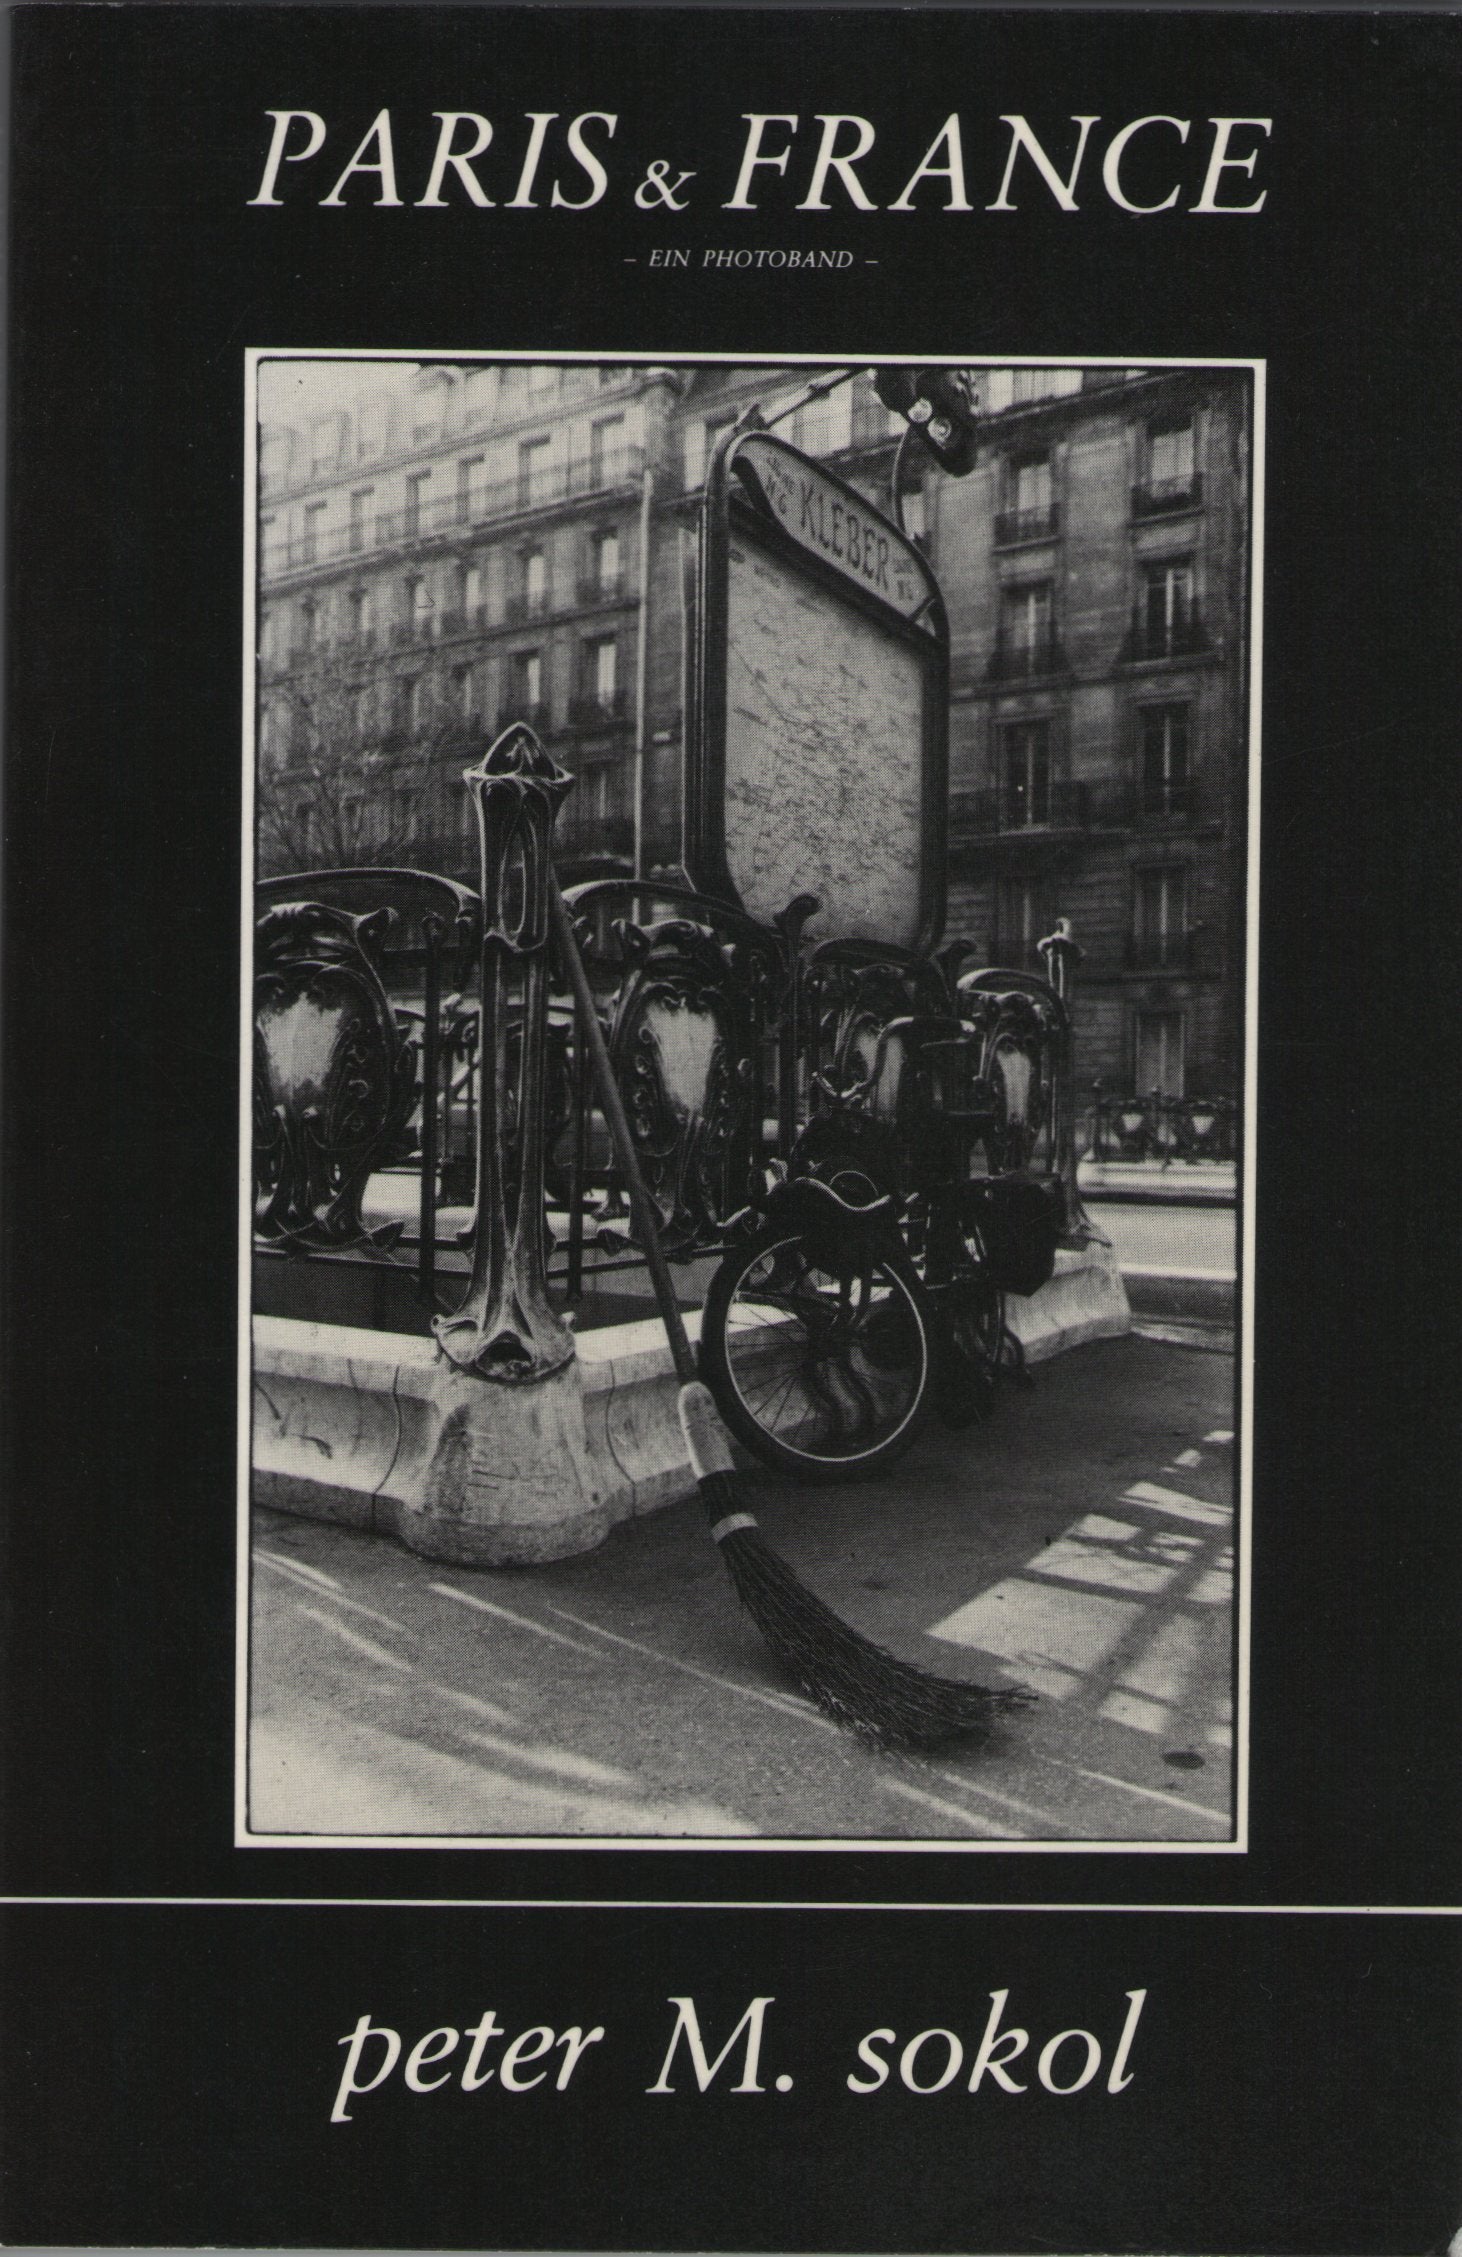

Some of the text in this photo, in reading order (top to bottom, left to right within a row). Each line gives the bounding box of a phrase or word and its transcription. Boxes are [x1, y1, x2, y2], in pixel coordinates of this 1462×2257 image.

[247, 109, 1273, 214] PARIS & FRANCE
[648, 249, 691, 268] EIN
[702, 249, 854, 269] PHOTOBAND
[331, 1988, 1147, 2123] peter M. sokol
